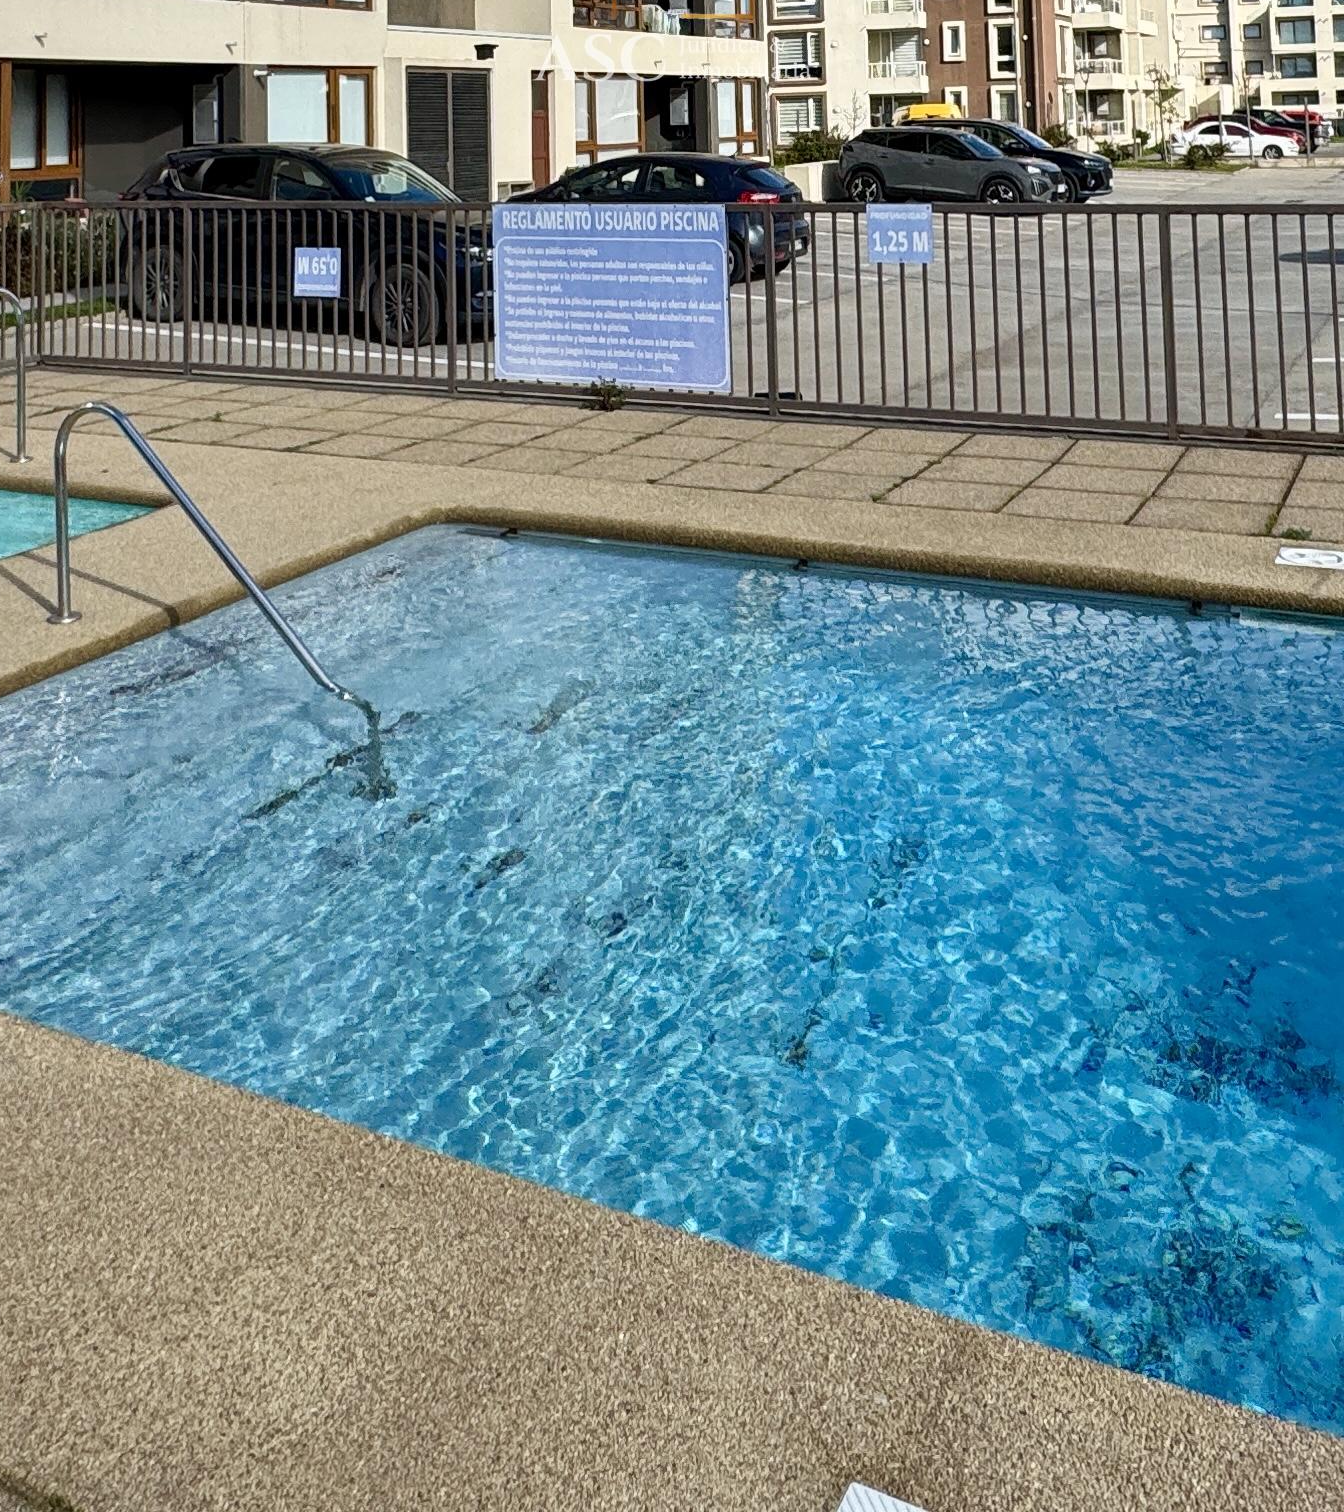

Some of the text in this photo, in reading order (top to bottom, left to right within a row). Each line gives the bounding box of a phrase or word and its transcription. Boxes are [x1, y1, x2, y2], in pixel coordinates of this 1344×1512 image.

[502, 210, 720, 232] REGLAMENTO USUARIO PISCINA
[872, 230, 929, 256] 1,25 M
[298, 255, 310, 275] M
